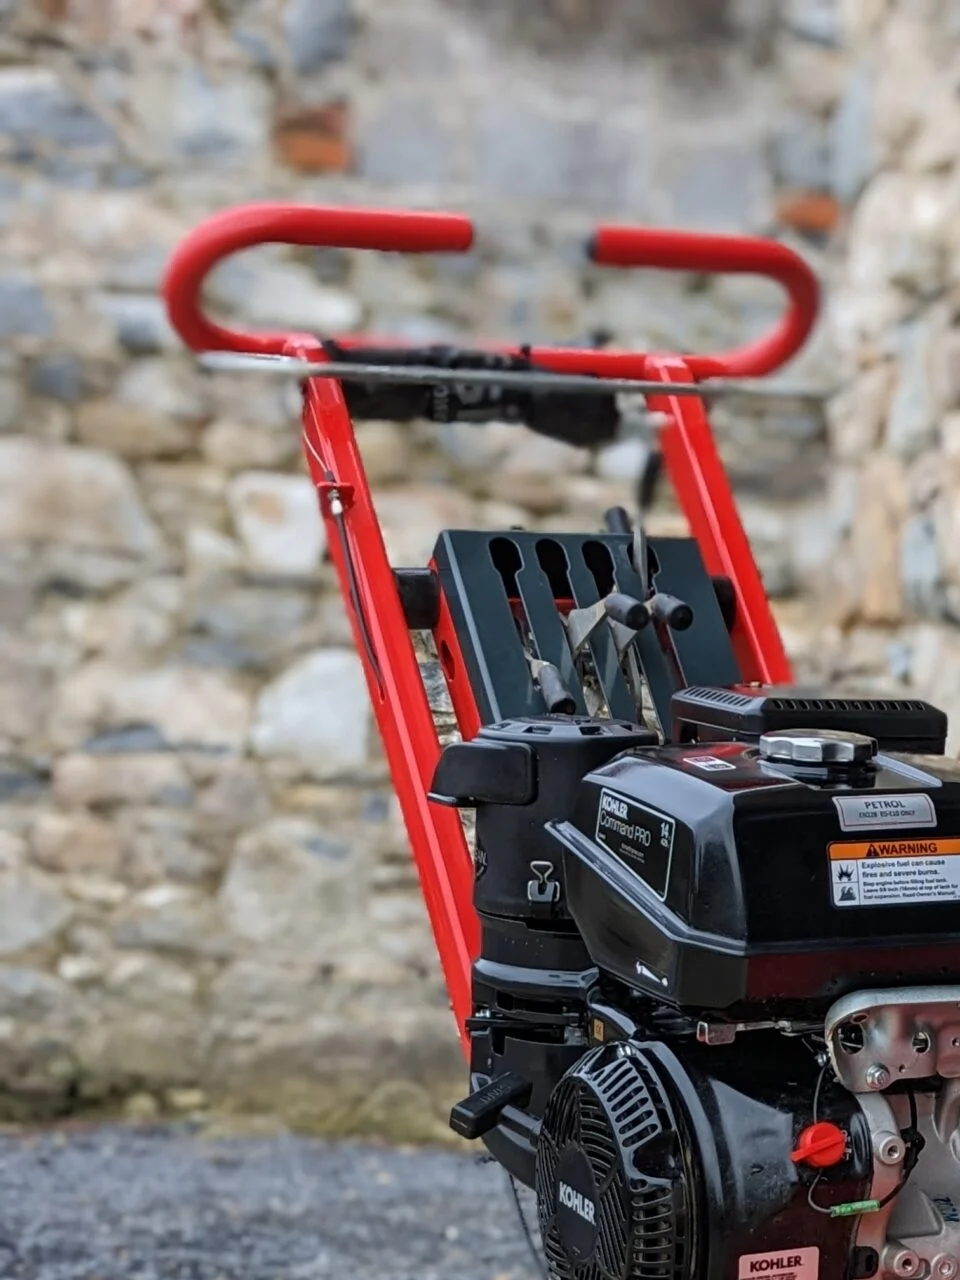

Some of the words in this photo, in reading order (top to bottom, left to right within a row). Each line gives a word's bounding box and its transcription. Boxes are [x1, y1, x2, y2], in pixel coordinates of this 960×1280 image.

[602, 794, 628, 820] KOHLER
[864, 800, 906, 809] PETROL
[600, 810, 635, 839] Command
[635, 825, 652, 847] PRO
[878, 842, 938, 855] WARNING
[862, 861, 895, 869] Explosive
[559, 1181, 597, 1226] KOHLER
[750, 1255, 802, 1273] KOHLER
